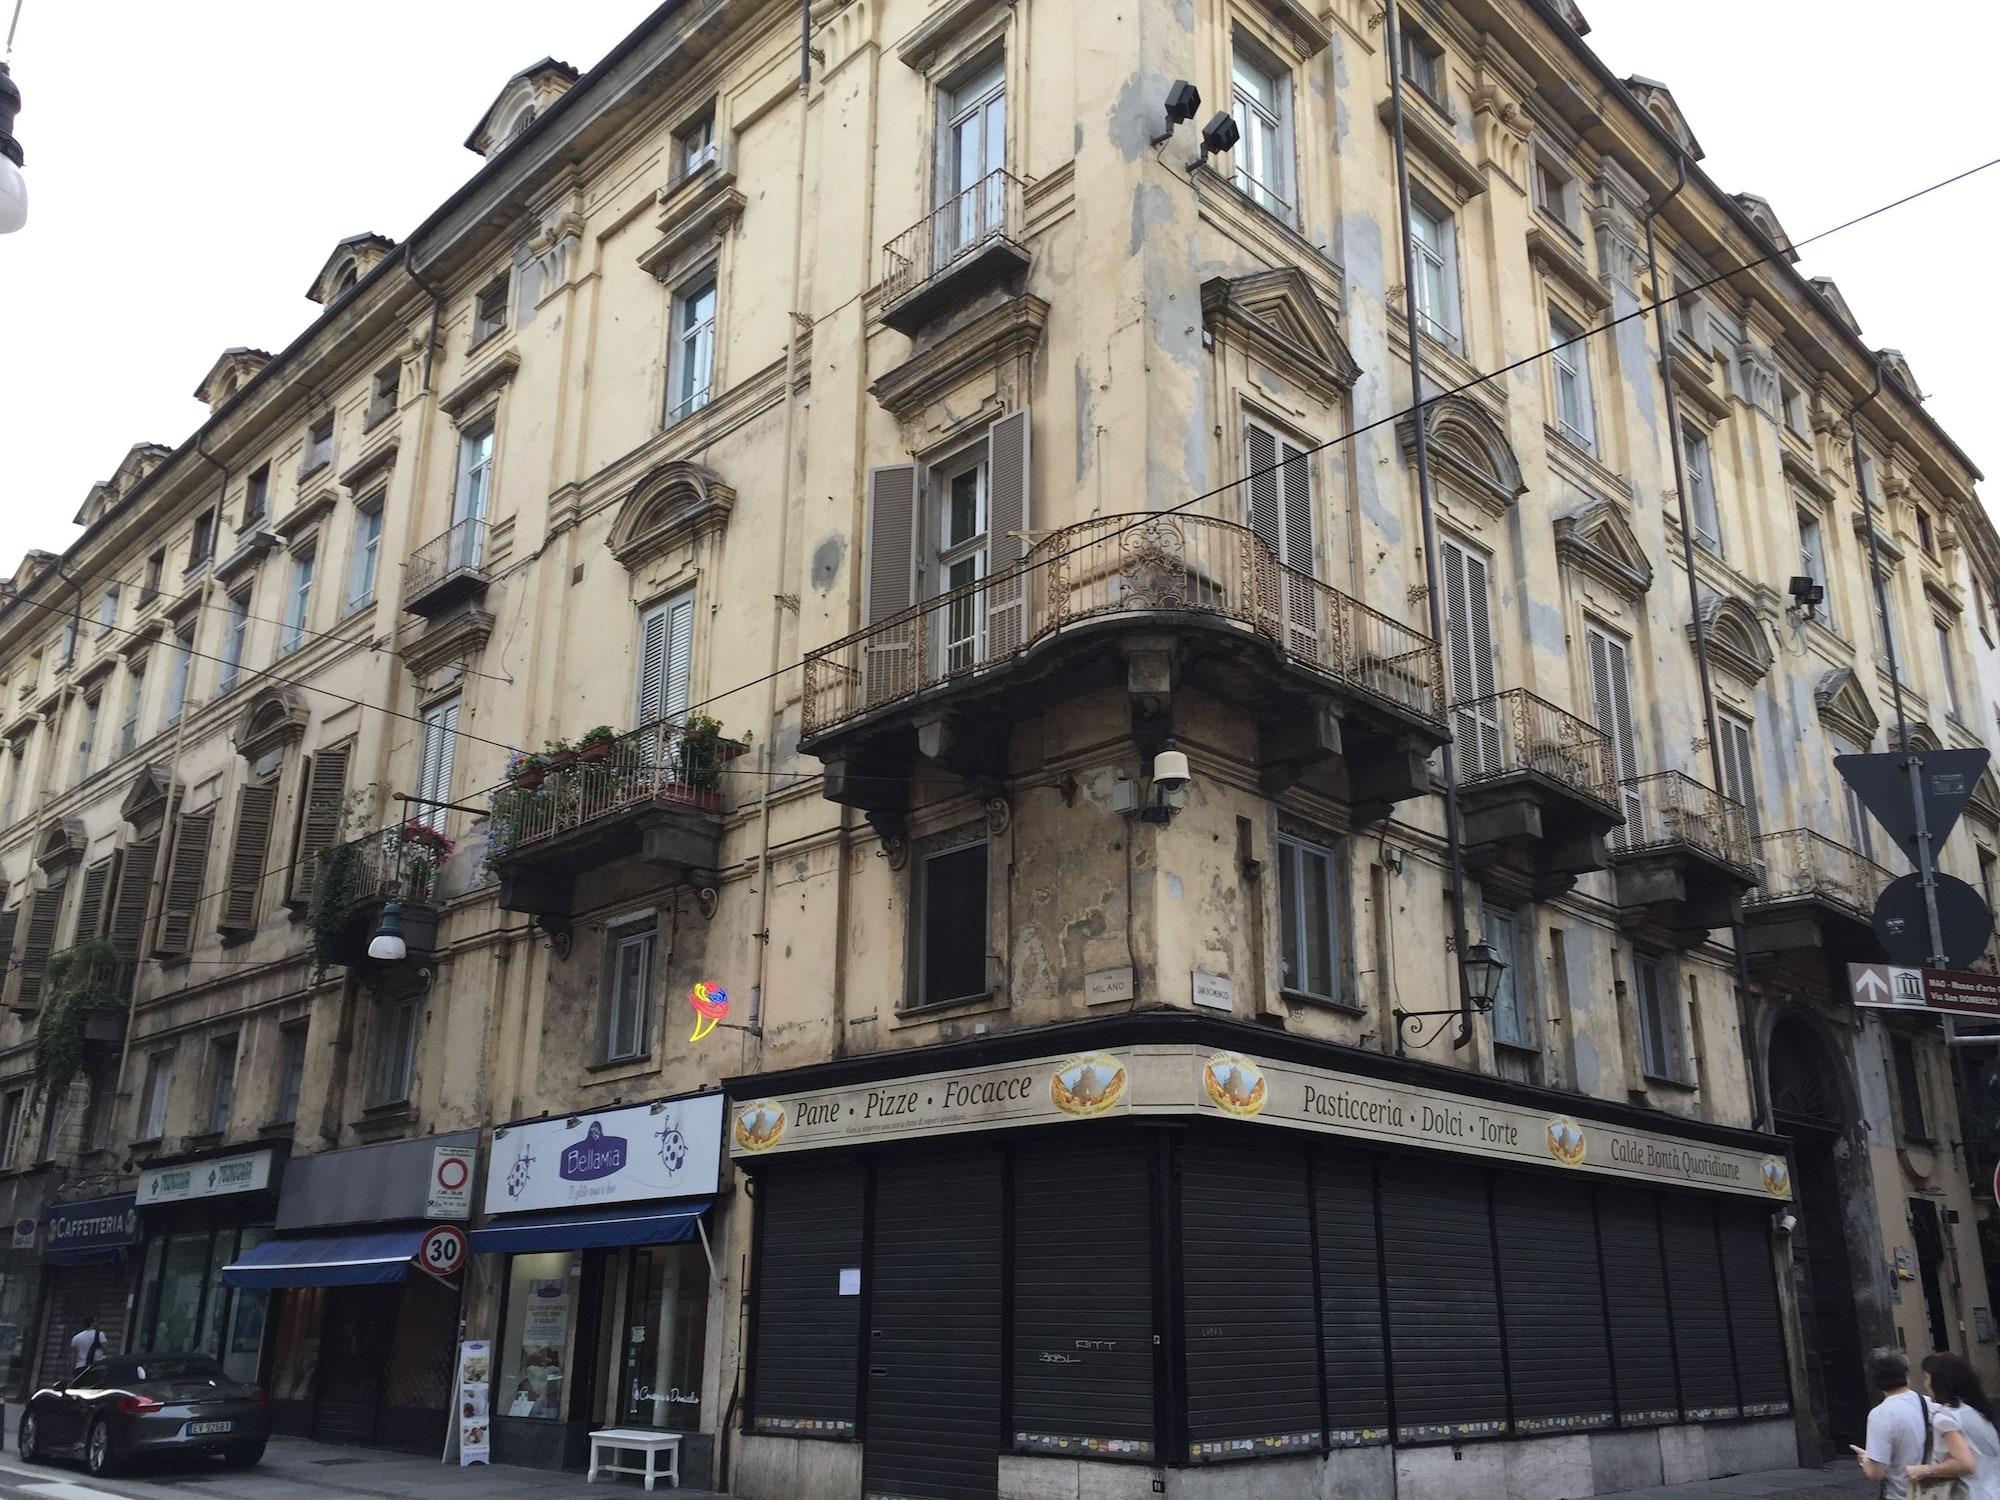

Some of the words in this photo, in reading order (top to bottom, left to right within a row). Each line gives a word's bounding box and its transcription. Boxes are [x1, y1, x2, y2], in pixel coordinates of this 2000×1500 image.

[1092, 982, 1125, 994] MILANO
[794, 1101, 840, 1128] Pane
[864, 1090, 919, 1119] Pizze
[942, 1075, 1033, 1109] Focacce
[1303, 1085, 1404, 1128] Pasticceria
[1421, 1106, 1464, 1137] Dolci
[1479, 1116, 1518, 1146] Torte
[1611, 1138, 1644, 1166] Calde
[1646, 1144, 1681, 1171] Bontà
[1682, 1151, 1740, 1181] Quotidiane
[57, 1215, 123, 1239] CAFFETTERIA
[430, 1239, 457, 1262] 30
